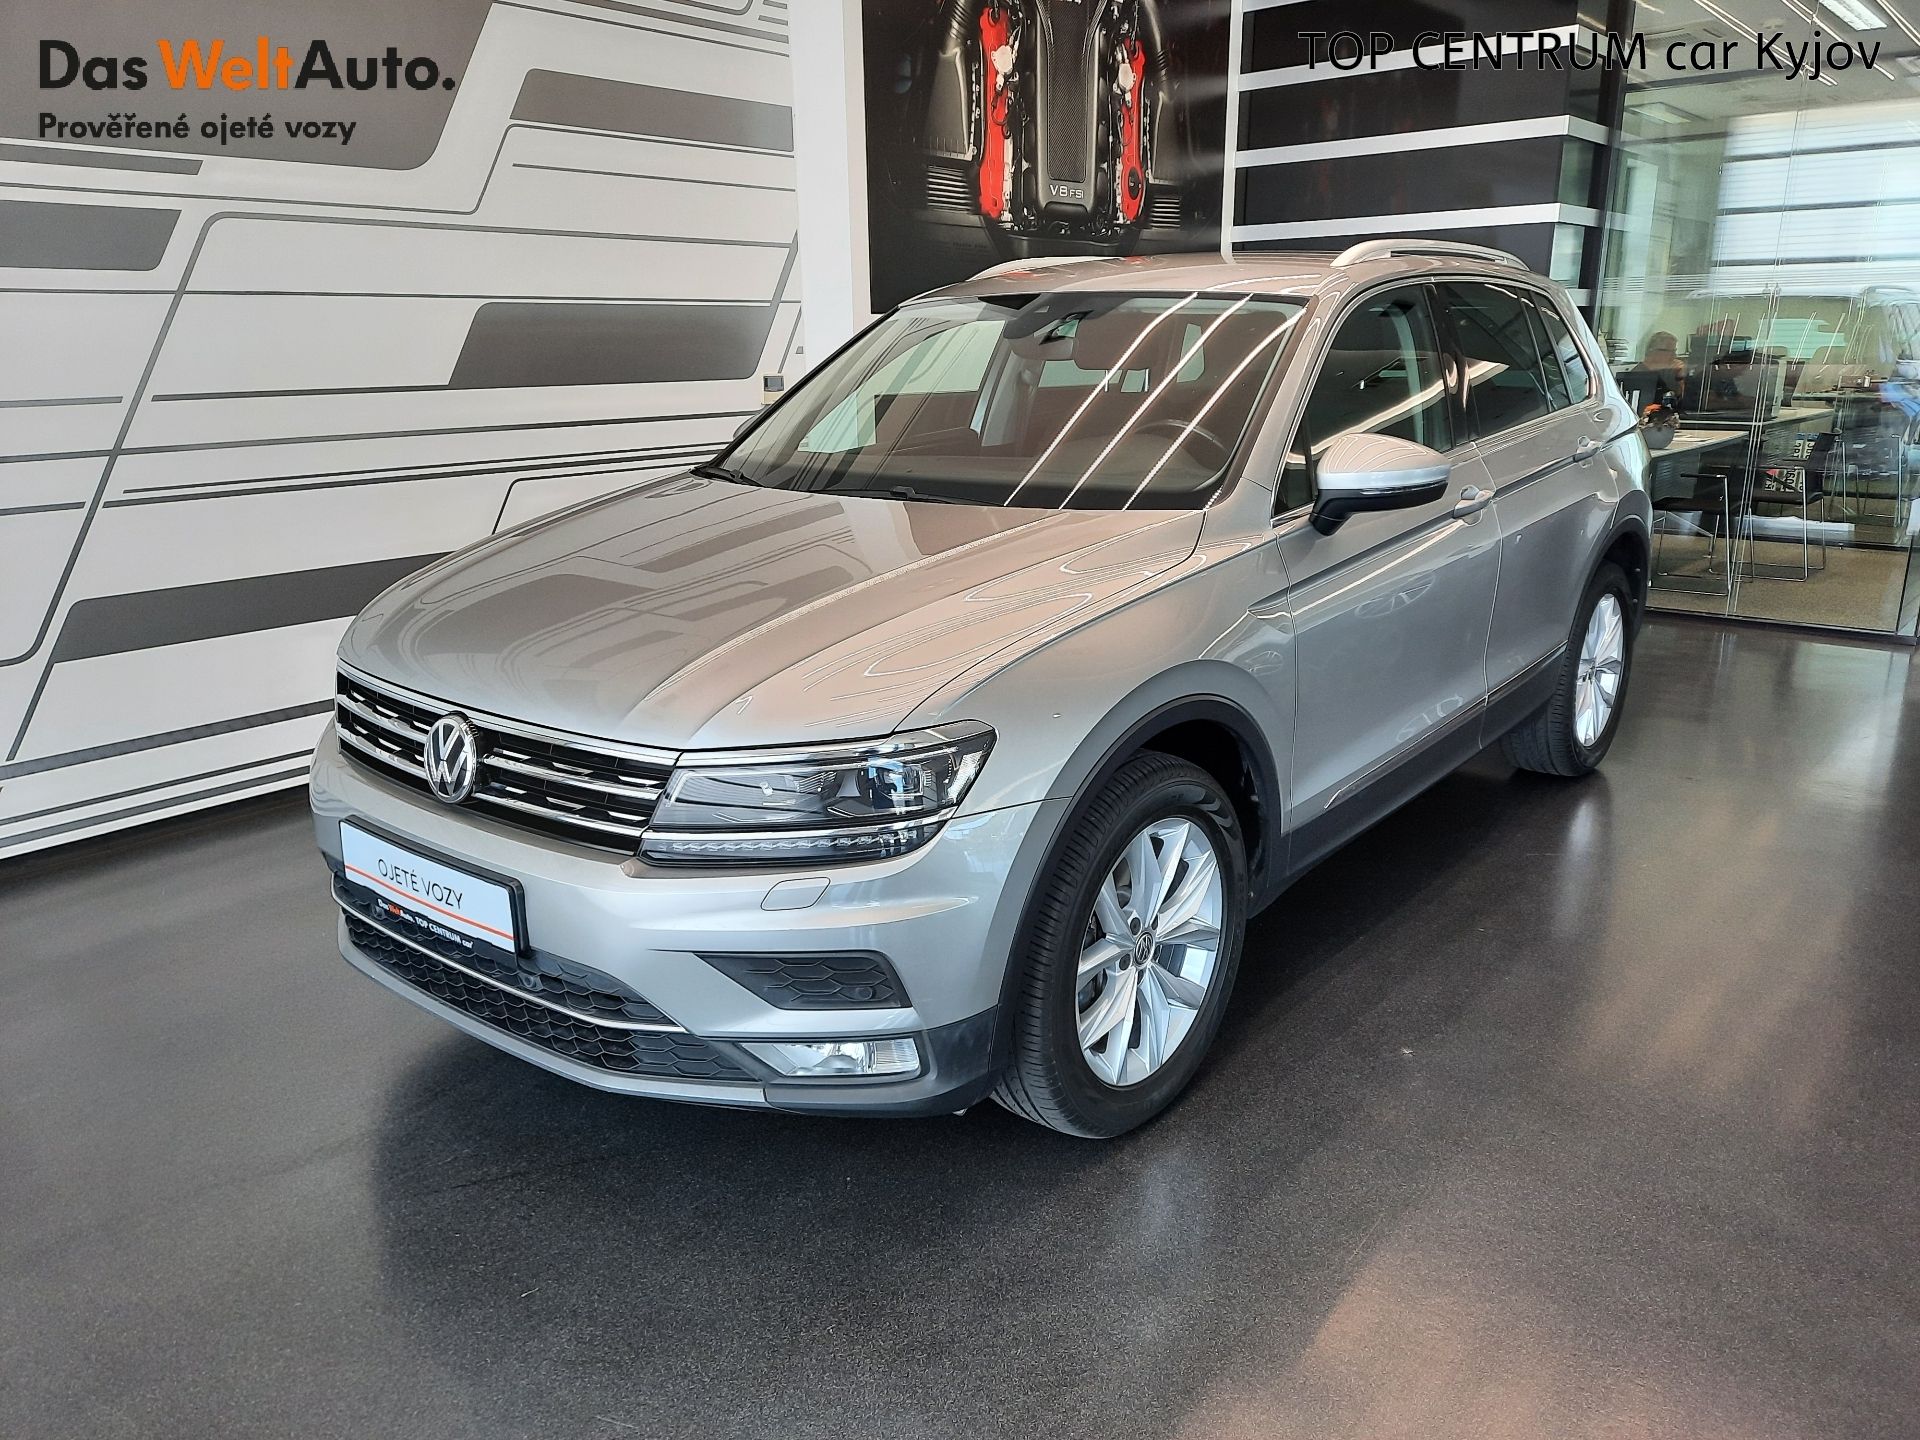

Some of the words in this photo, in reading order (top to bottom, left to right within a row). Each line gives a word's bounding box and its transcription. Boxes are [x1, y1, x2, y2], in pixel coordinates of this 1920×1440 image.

[1049, 184, 1068, 197] V8
[1069, 189, 1084, 199] FSI
[377, 858, 420, 893] OJETÉ
[420, 877, 463, 909] VOZY
